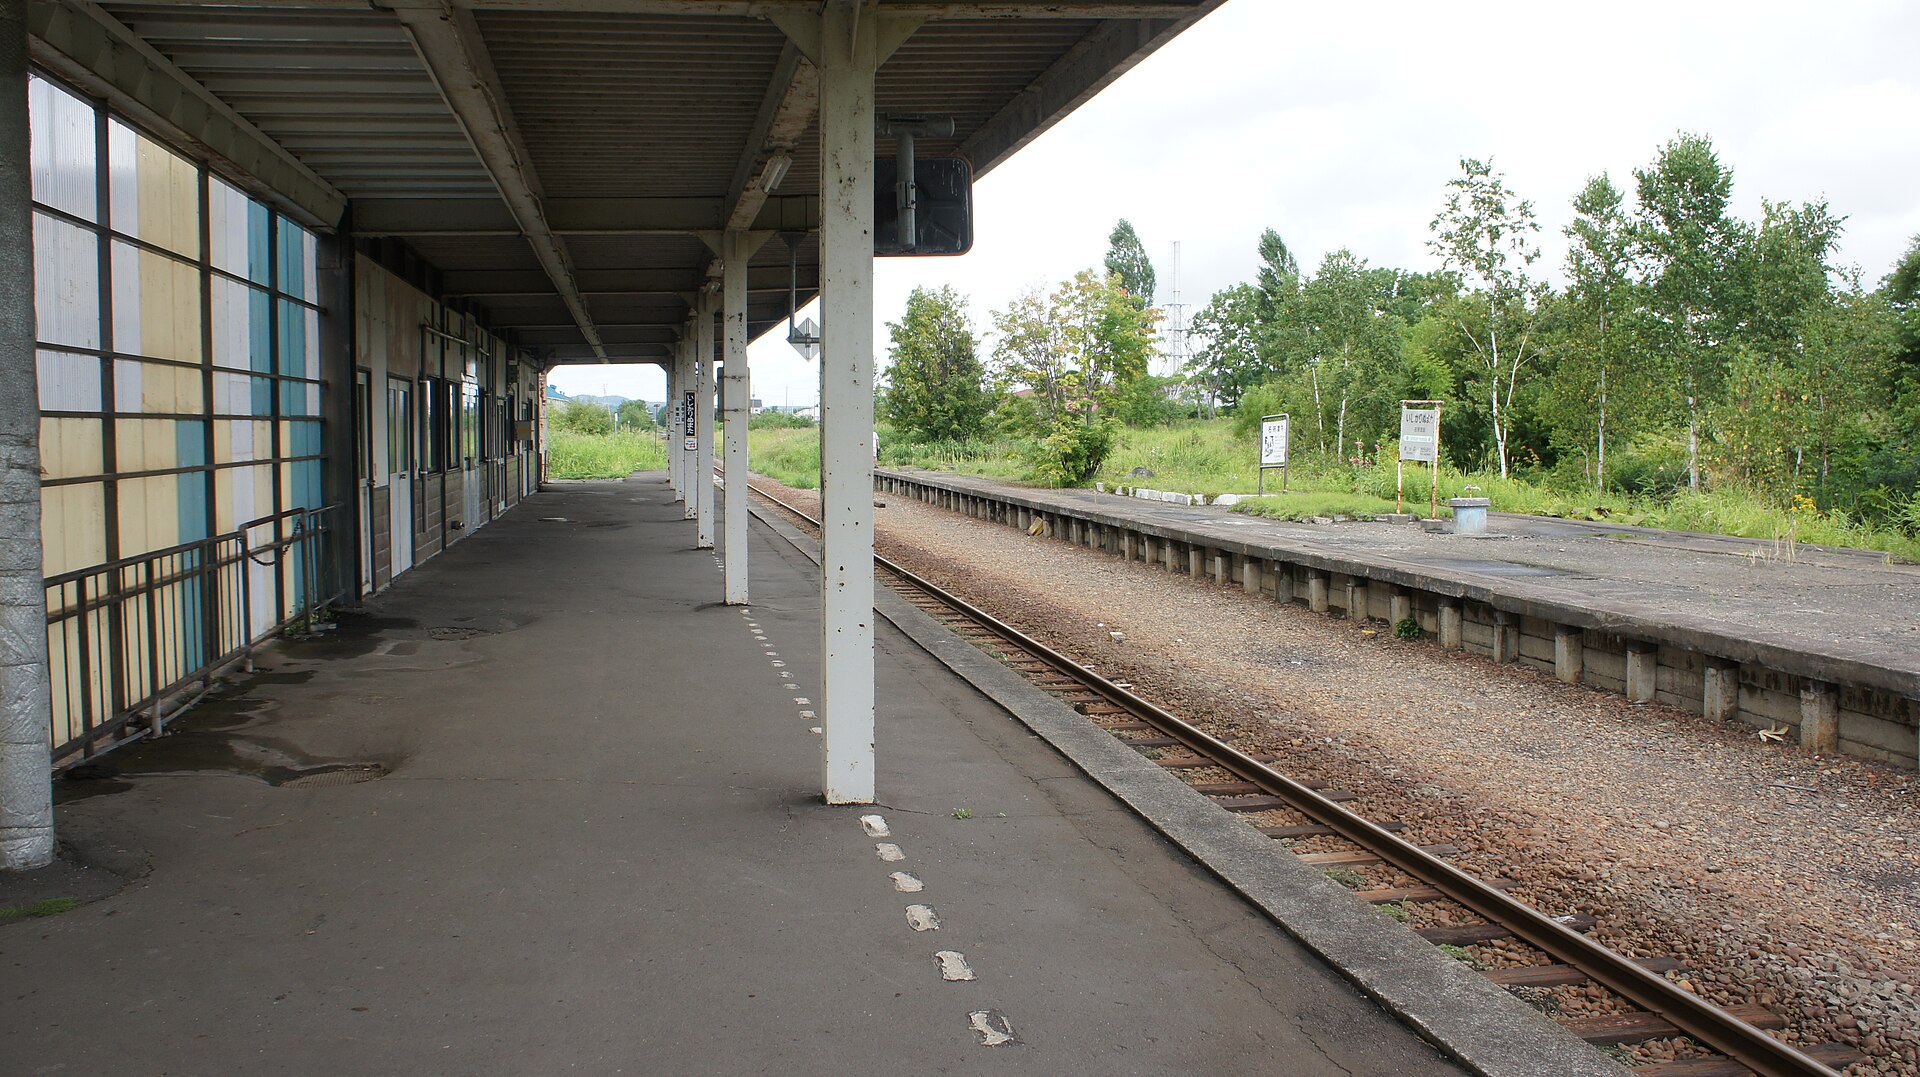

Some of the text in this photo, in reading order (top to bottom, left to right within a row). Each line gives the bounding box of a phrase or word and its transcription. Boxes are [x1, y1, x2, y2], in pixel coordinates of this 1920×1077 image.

[686, 394, 695, 434] いしかりぬまた
[1405, 413, 1434, 424] いしかりぬまた
